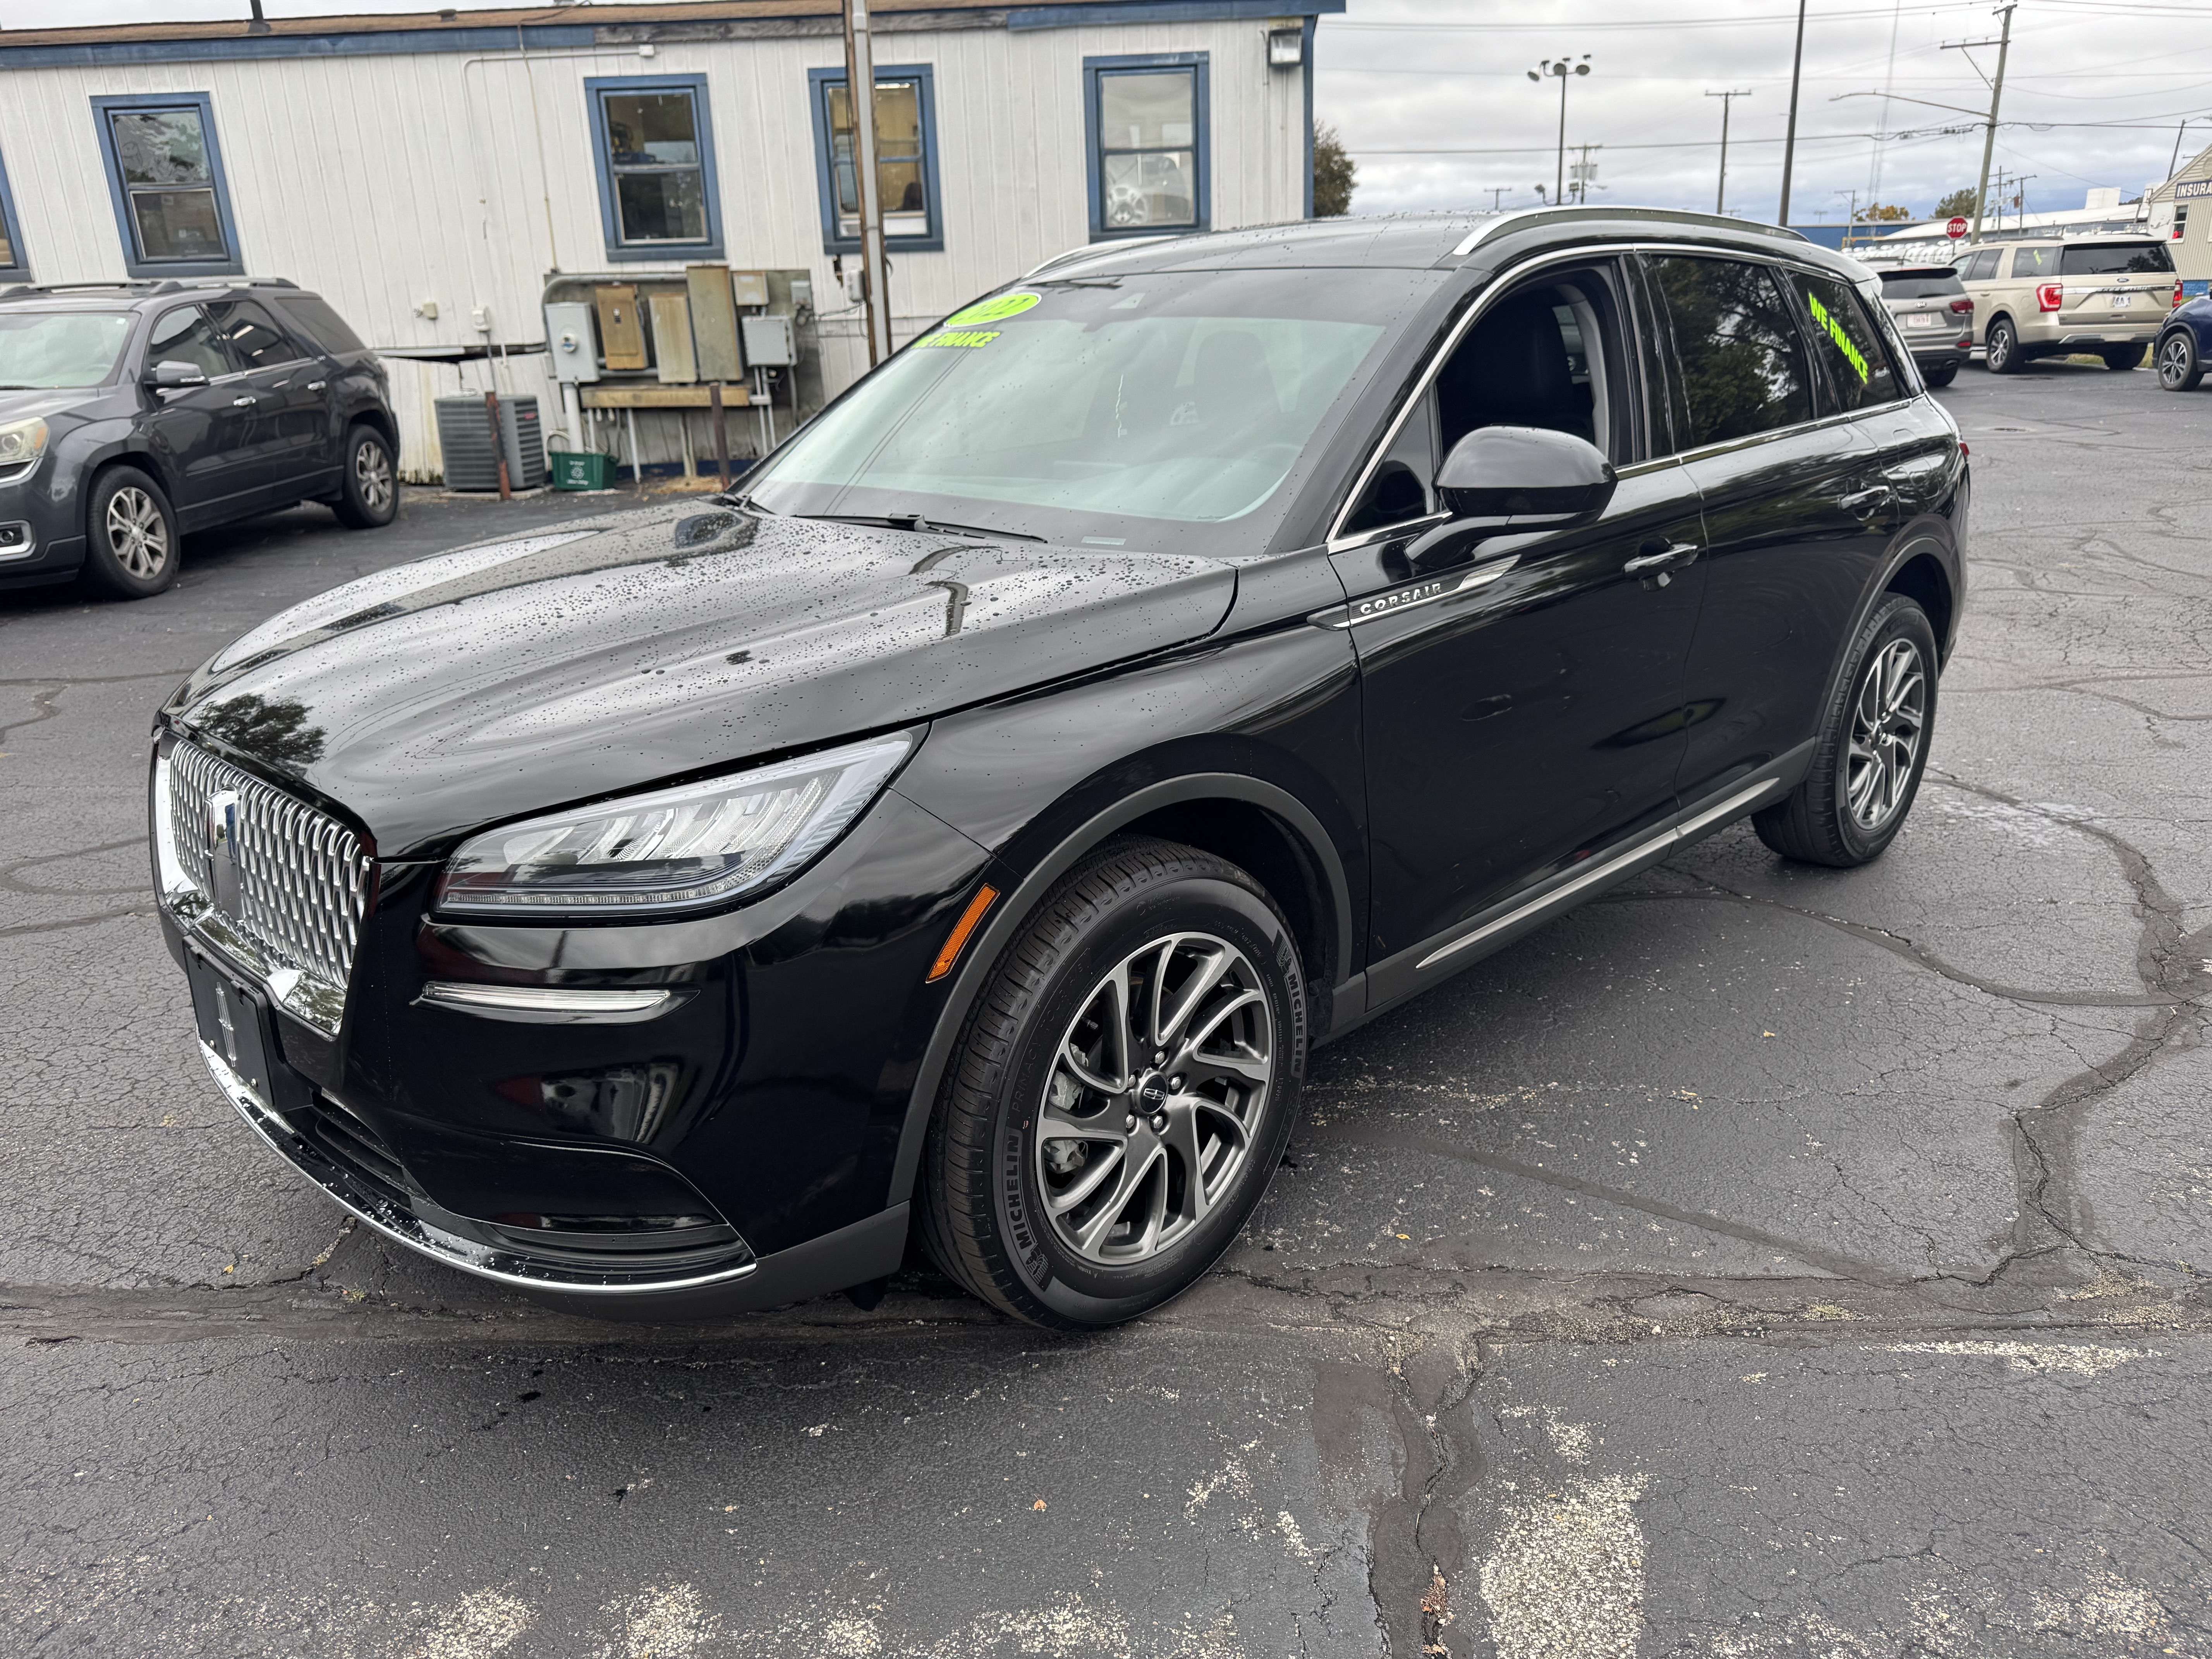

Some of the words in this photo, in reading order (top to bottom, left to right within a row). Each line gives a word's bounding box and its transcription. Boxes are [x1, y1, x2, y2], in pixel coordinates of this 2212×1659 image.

[2176, 182, 2212, 198] INSURA
[1948, 223, 1966, 233] STOP
[930, 332, 1001, 347] FINANCE
[1808, 292, 1828, 331] WE
[1829, 317, 1869, 385] FINANCE
[1360, 582, 1442, 615] CORSAIR
[1288, 972, 1304, 1073] MICHELIN
[1006, 1134, 1032, 1250] MICHELIN
